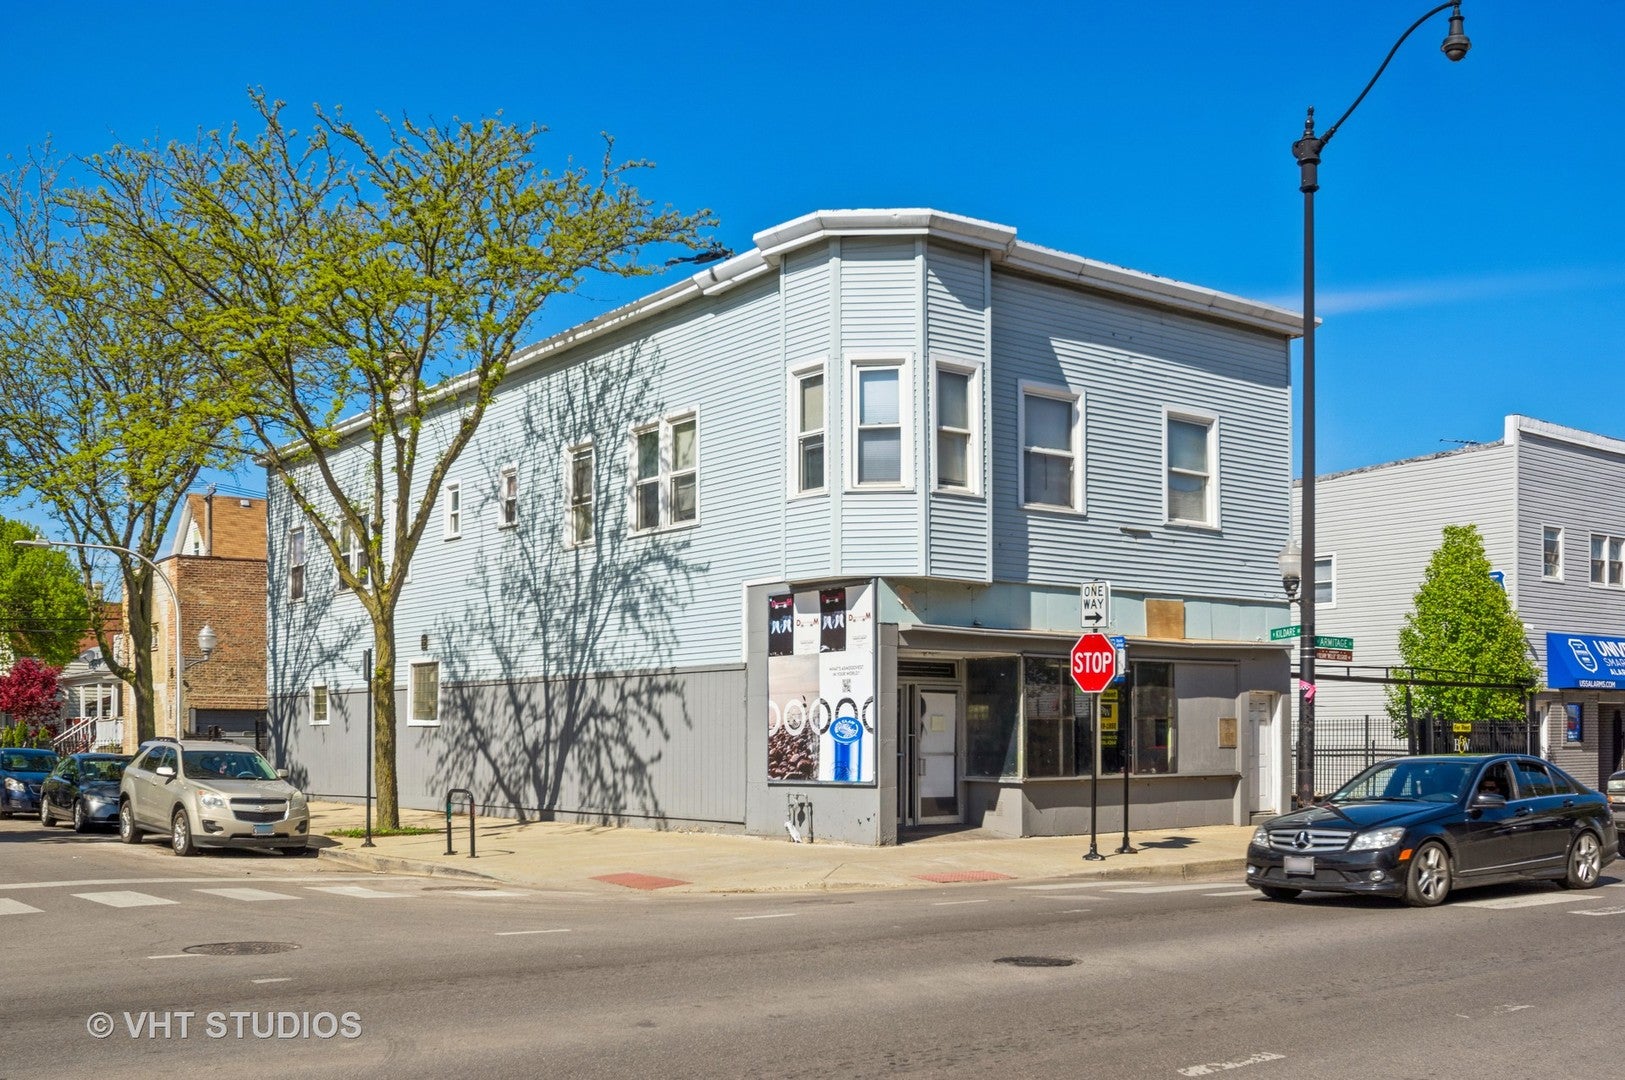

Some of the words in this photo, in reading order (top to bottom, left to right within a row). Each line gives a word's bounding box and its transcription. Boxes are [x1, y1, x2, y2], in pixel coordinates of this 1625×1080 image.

[1084, 586, 1104, 597] ONE
[1083, 599, 1104, 609] WAY
[1275, 627, 1296, 638] KILDARE
[1320, 637, 1348, 648] ARMITAGE
[1074, 652, 1112, 673] STOP
[1579, 680, 1616, 688] USSALARMS.COM
